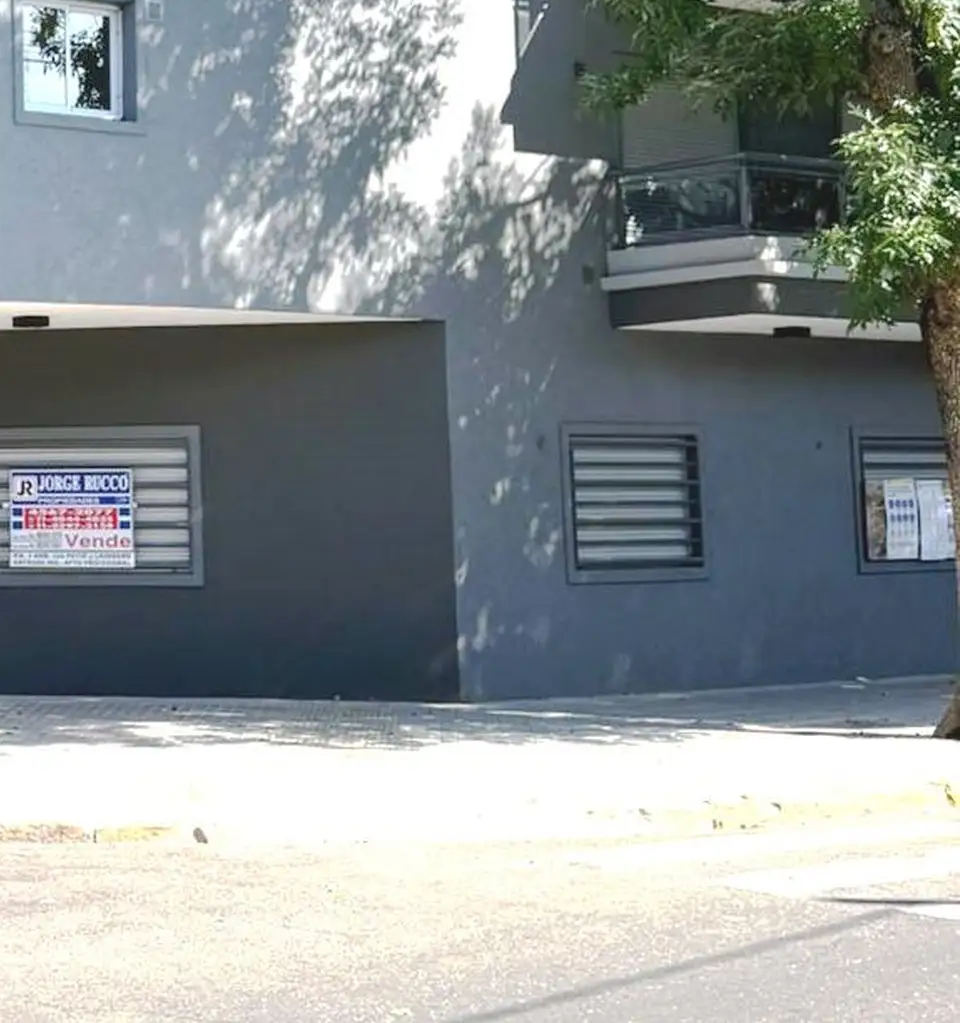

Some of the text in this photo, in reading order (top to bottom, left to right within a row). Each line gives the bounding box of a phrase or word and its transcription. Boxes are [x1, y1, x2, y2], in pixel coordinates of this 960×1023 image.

[38, 474, 128, 492] JORGE RUCCO
[65, 534, 131, 549] Vende
